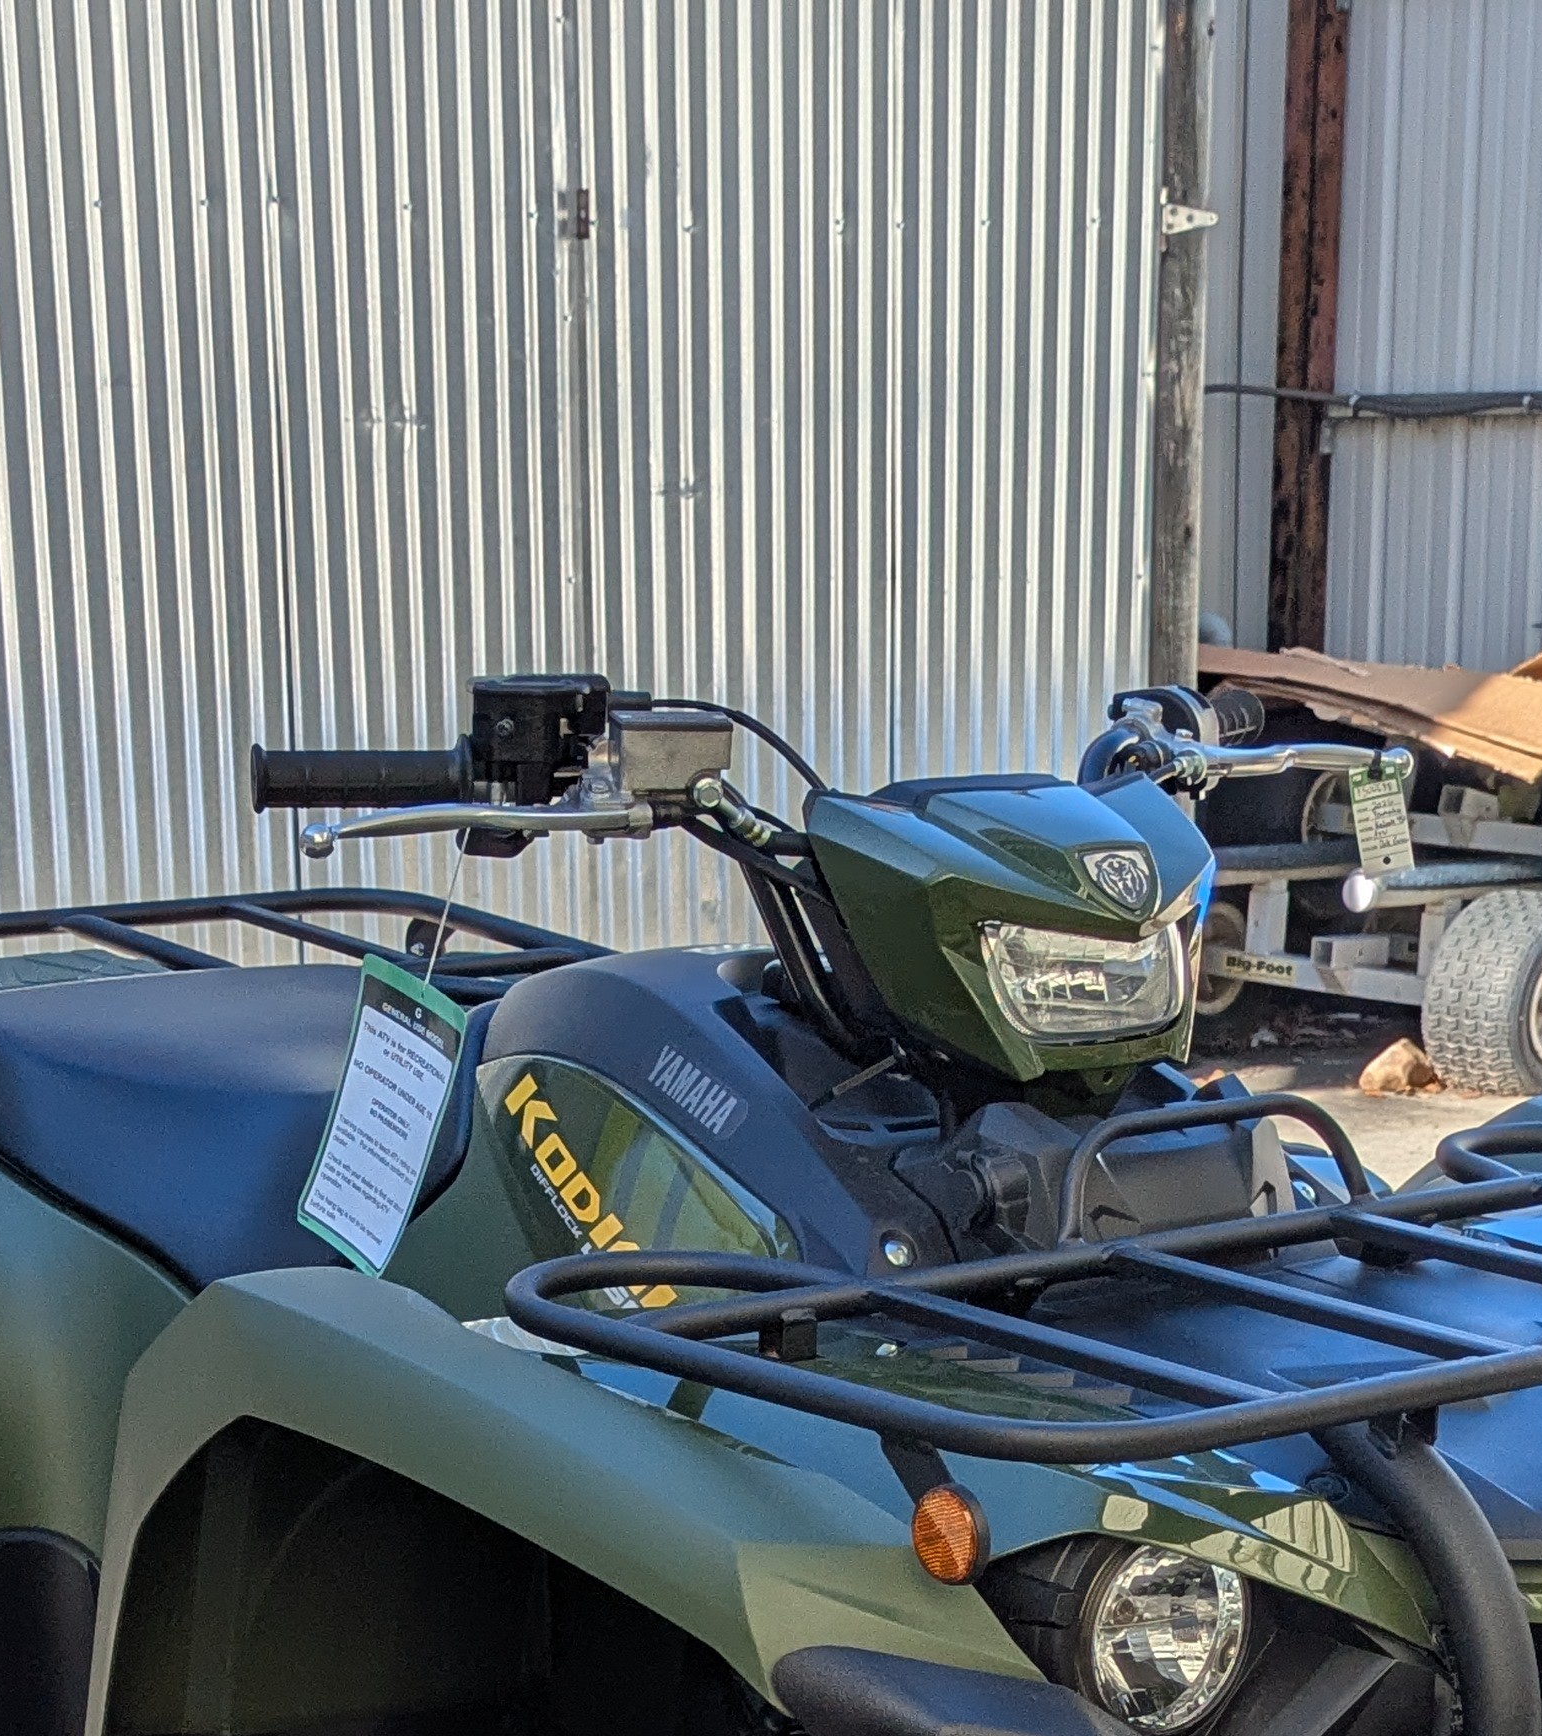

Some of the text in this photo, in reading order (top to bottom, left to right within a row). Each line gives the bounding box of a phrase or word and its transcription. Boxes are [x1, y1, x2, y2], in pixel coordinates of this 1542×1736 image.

[377, 1031, 391, 1043] ATV
[382, 1002, 412, 1027] GENERAL
[413, 1021, 425, 1035] USE
[415, 1007, 422, 1019] G
[648, 1045, 738, 1135] YAMAHA
[504, 1072, 678, 1308] KODI
[530, 1163, 583, 1239] DIFFLOCK
